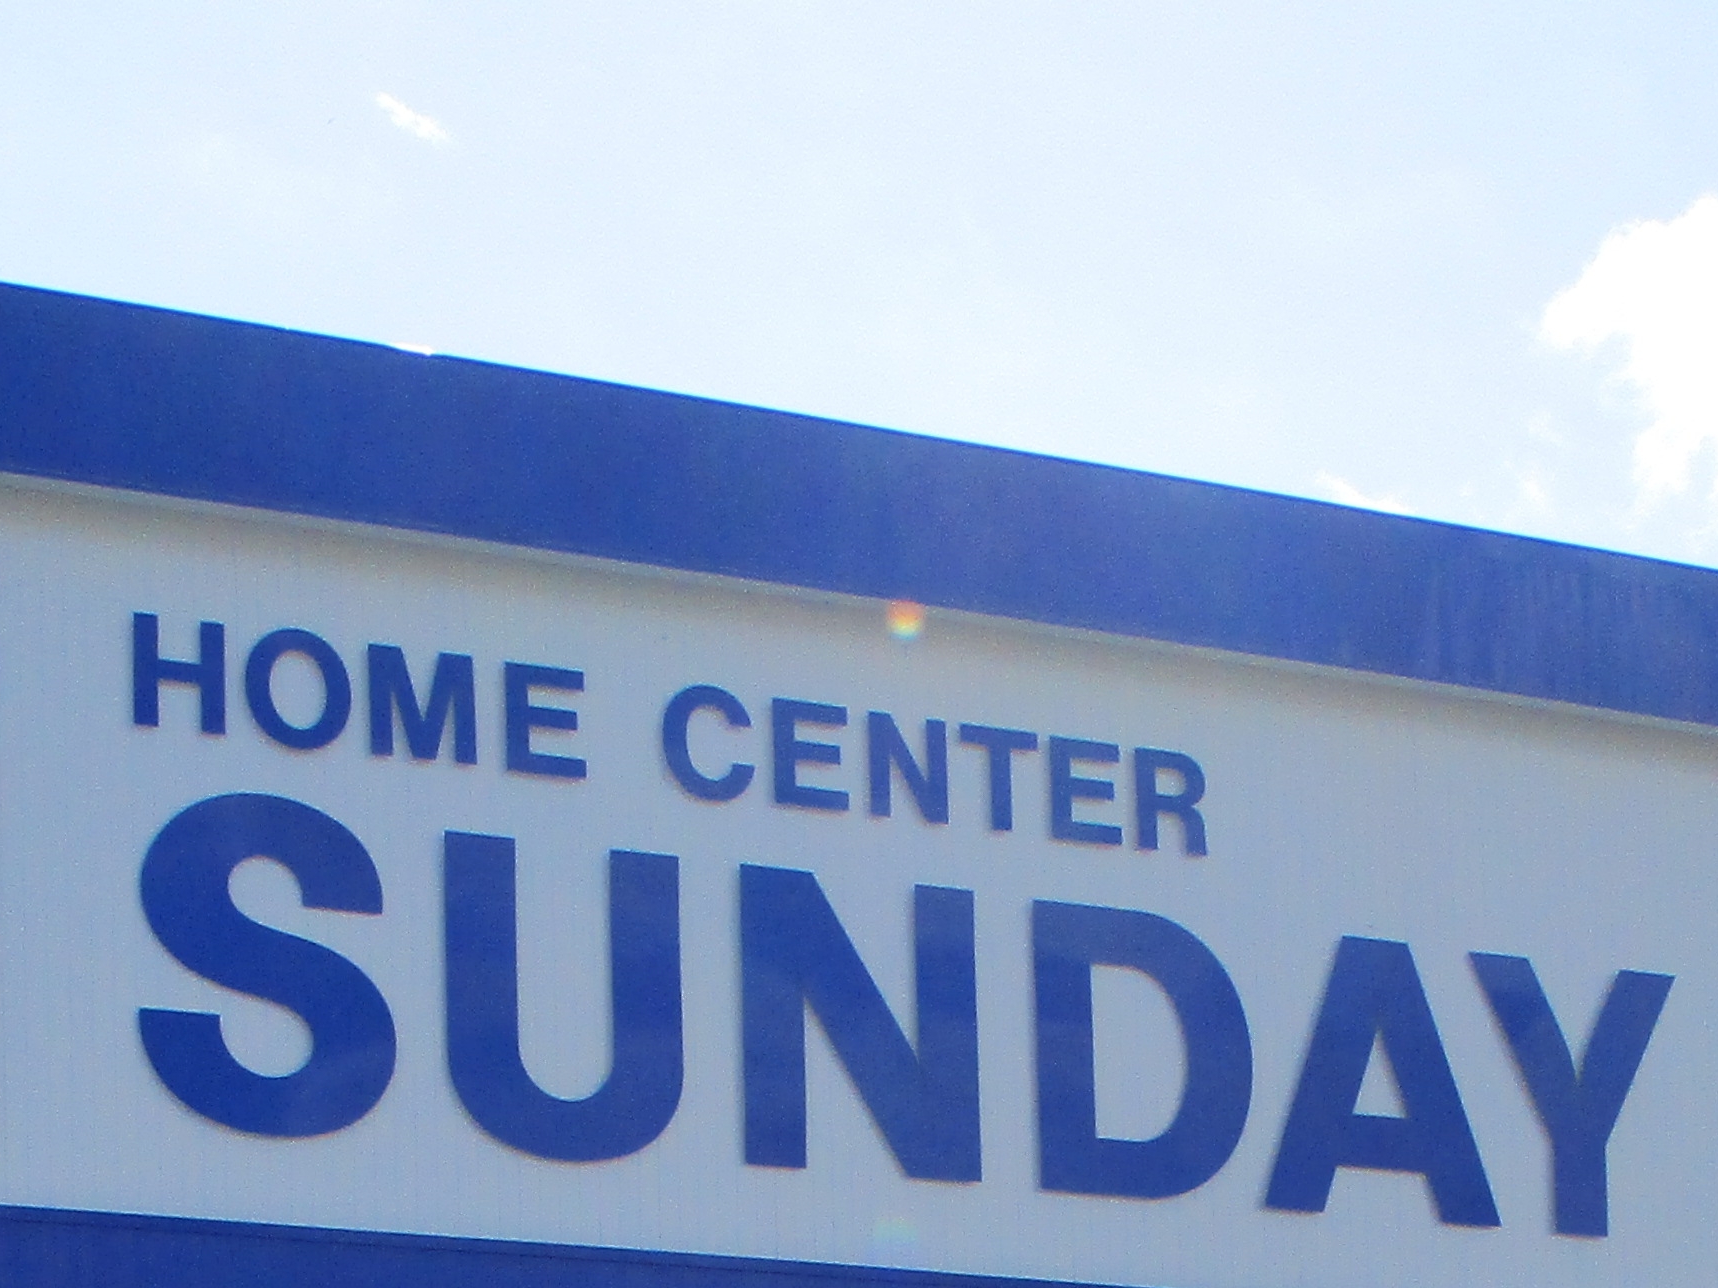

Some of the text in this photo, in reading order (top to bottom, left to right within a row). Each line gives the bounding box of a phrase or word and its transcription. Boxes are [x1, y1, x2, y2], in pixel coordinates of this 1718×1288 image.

[132, 612, 1212, 860] HOME CENTER
[136, 792, 1676, 1241] SUNDAY
